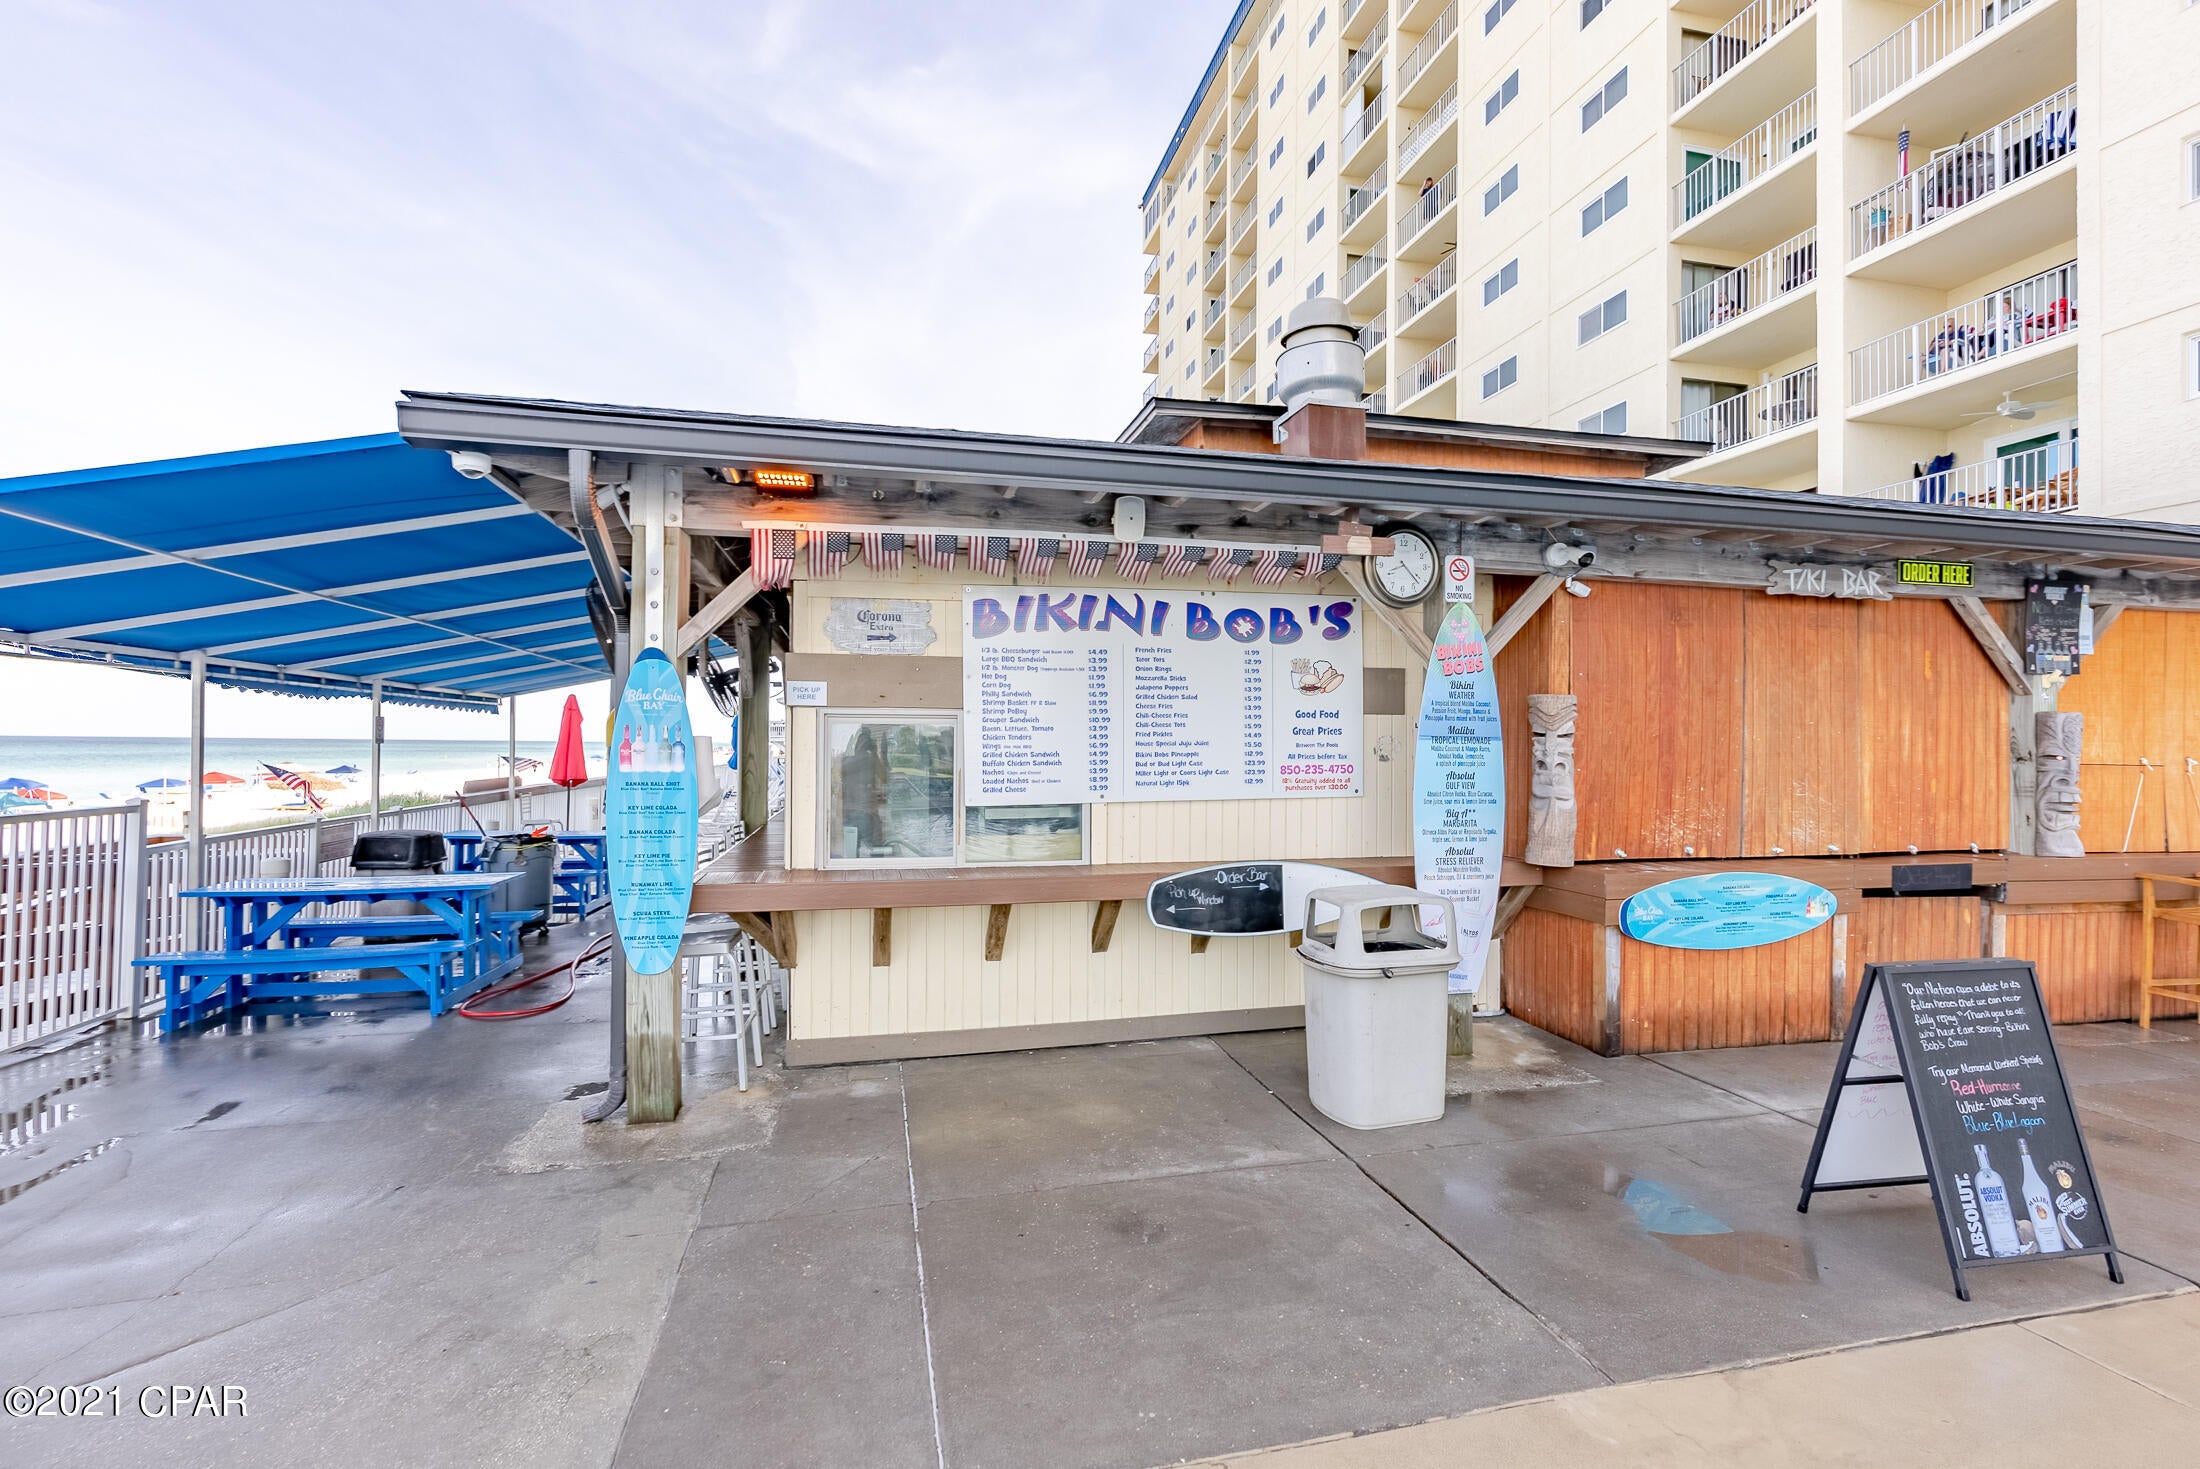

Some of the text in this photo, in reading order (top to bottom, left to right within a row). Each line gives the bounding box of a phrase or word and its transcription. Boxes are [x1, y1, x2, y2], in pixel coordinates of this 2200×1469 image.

[1902, 562, 1970, 584] ORDER HERE
[1782, 568, 1884, 596] TIKI BAR
[857, 609, 902, 623] Corona
[972, 592, 1354, 645] BIKINI BOB'S
[869, 622, 894, 631] Extra
[1436, 641, 1482, 661] BIKINI
[1442, 657, 1484, 676] BOBS
[1450, 681, 1474, 689] Bikini
[625, 688, 683, 703] Blue Chair
[643, 701, 665, 710] BAY
[1295, 710, 1339, 719] Good Food
[1292, 727, 1342, 736] Great Prices
[1448, 725, 1475, 734] Malibu
[1431, 736, 1491, 744] TROPICAL LEMONADE
[1280, 764, 1354, 775] 850-235-4750
[1446, 771, 1475, 780] Absolut
[1445, 809, 1460, 820] Big
[1445, 846, 1474, 856] Absolut
[1436, 857, 1484, 865] STRESS RELIEVER
[1216, 867, 1268, 884] Order Bar
[1188, 888, 1200, 899] up
[1197, 892, 1224, 905] Window
[1924, 982, 1955, 995] Nation
[1980, 982, 1998, 992] debt
[2000, 980, 2009, 989] to
[2008, 980, 2021, 989] its
[1910, 999, 1934, 1012] fallen
[1934, 998, 1958, 1008] heroes
[1958, 996, 1975, 1008] that
[1988, 996, 2001, 1004] can
[1915, 1014, 1934, 1030] fully
[1964, 1009, 1992, 1021] Thank
[1991, 1011, 2005, 1023] you
[2006, 1008, 2014, 1016] to
[1919, 1030, 1934, 1040] who
[1937, 1028, 1956, 1038] have
[1920, 1038, 1968, 1052] Bob's Crew
[1928, 1065, 1948, 1085] Try
[1946, 1067, 1959, 1077] our
[1960, 1063, 1994, 1074] Memorial
[2012, 1094, 2046, 1110] Sangria
[2048, 1160, 2076, 1175] MALIBU
[1980, 1185, 2003, 1195] ABSOLUT
[1983, 1194, 2004, 1203] VODKA
[2028, 1196, 2050, 1207] MALIBU
